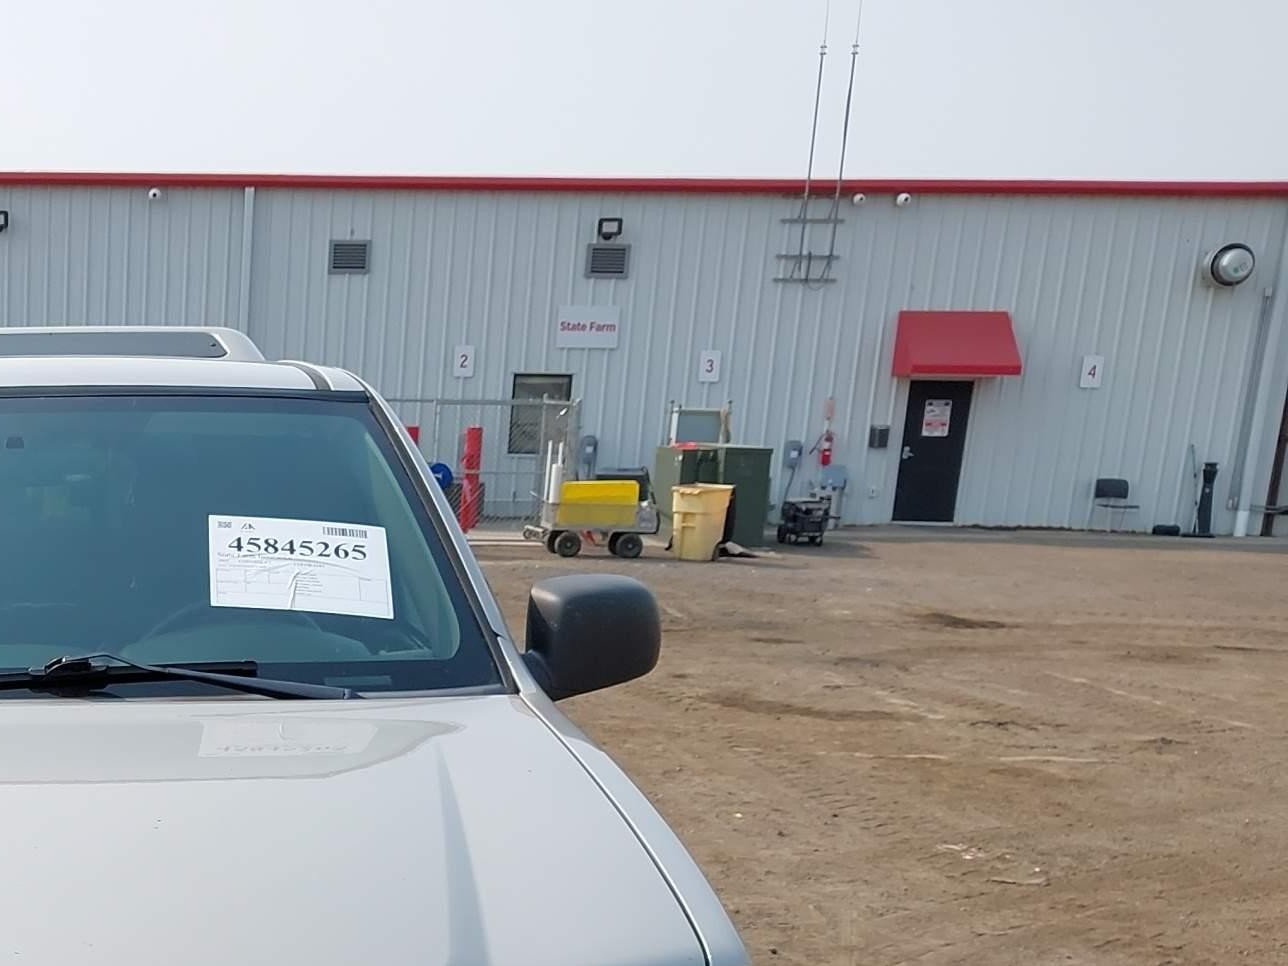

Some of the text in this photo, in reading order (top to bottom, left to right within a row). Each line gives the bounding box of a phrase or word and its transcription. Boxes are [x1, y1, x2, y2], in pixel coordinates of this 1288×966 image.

[559, 320, 616, 333] State Farm
[459, 353, 469, 369] 2
[705, 358, 715, 374] 3
[1087, 364, 1098, 380] 4
[227, 536, 368, 561] 45845265
